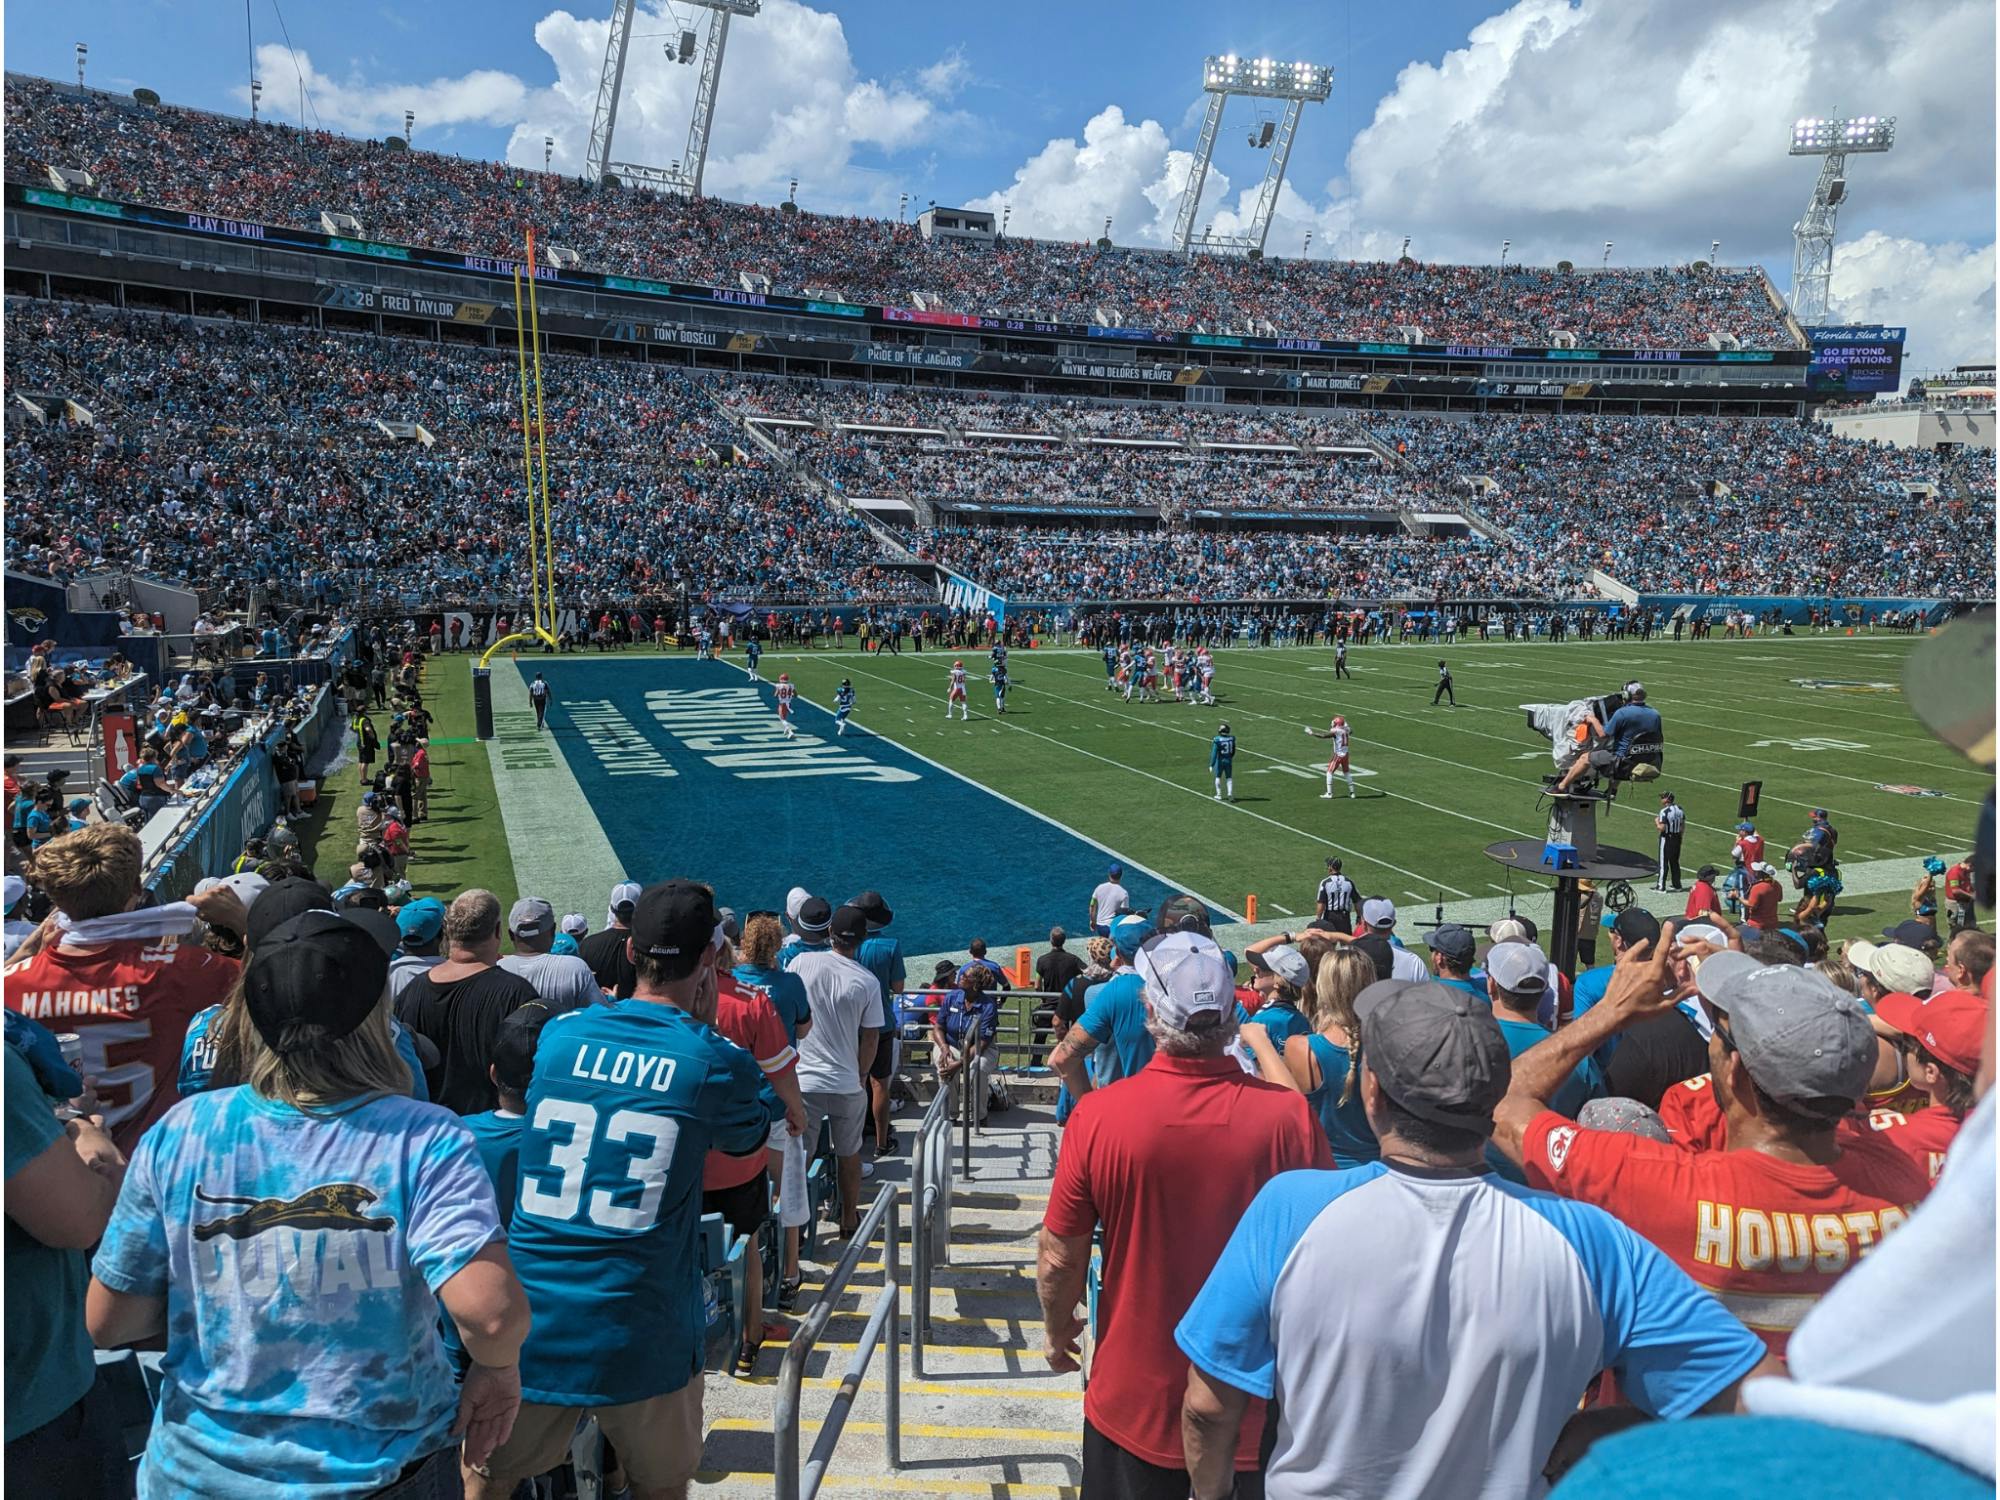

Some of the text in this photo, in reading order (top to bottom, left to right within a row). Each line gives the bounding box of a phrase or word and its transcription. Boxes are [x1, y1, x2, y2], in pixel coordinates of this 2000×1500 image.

[188, 215, 264, 239] PLAY TO WIN
[464, 257, 492, 272] MEET
[495, 261, 514, 275] THE
[356, 292, 454, 317] 28 FRED TAYLOR
[712, 290, 766, 306] PLAY TO WIN
[984, 318, 999, 328] 2ND
[1006, 321, 1024, 330] 0:28
[1097, 328, 1104, 337] 3
[654, 328, 677, 342] TONY
[681, 331, 716, 346] BOSELLI
[1277, 338, 1321, 350] PLAY TO WIN
[1813, 330, 1878, 340] Florida Blue
[867, 348, 962, 367] PRIDE OF THE JAGUARS
[1446, 346, 1513, 358] MEET THE MOMENT
[1634, 350, 1681, 360] PLAY TO WIN
[1815, 356, 1893, 364] EXPECTATIONS
[1823, 347, 1885, 356] GO BEYOND
[1061, 363, 1087, 376] WAYNE
[1089, 365, 1104, 377] AND
[1106, 367, 1140, 379] DELORES
[1142, 369, 1172, 381] WEAVER
[1306, 377, 1328, 389] MARK
[1329, 378, 1361, 390] BRUNELL
[1496, 384, 1509, 394] 82
[1513, 385, 1538, 395] JIMMY
[1540, 385, 1564, 396] SMITH
[561, 700, 680, 778] JACKSONVILLE
[643, 687, 923, 783] JAGUARS
[1220, 740, 1234, 755] 31
[1745, 784, 1756, 805] 1
[21, 985, 141, 1019] MAHOMES
[571, 1044, 677, 1093] LLOYD
[520, 1097, 680, 1231] 33
[1694, 1199, 1919, 1274] HOUSTO
